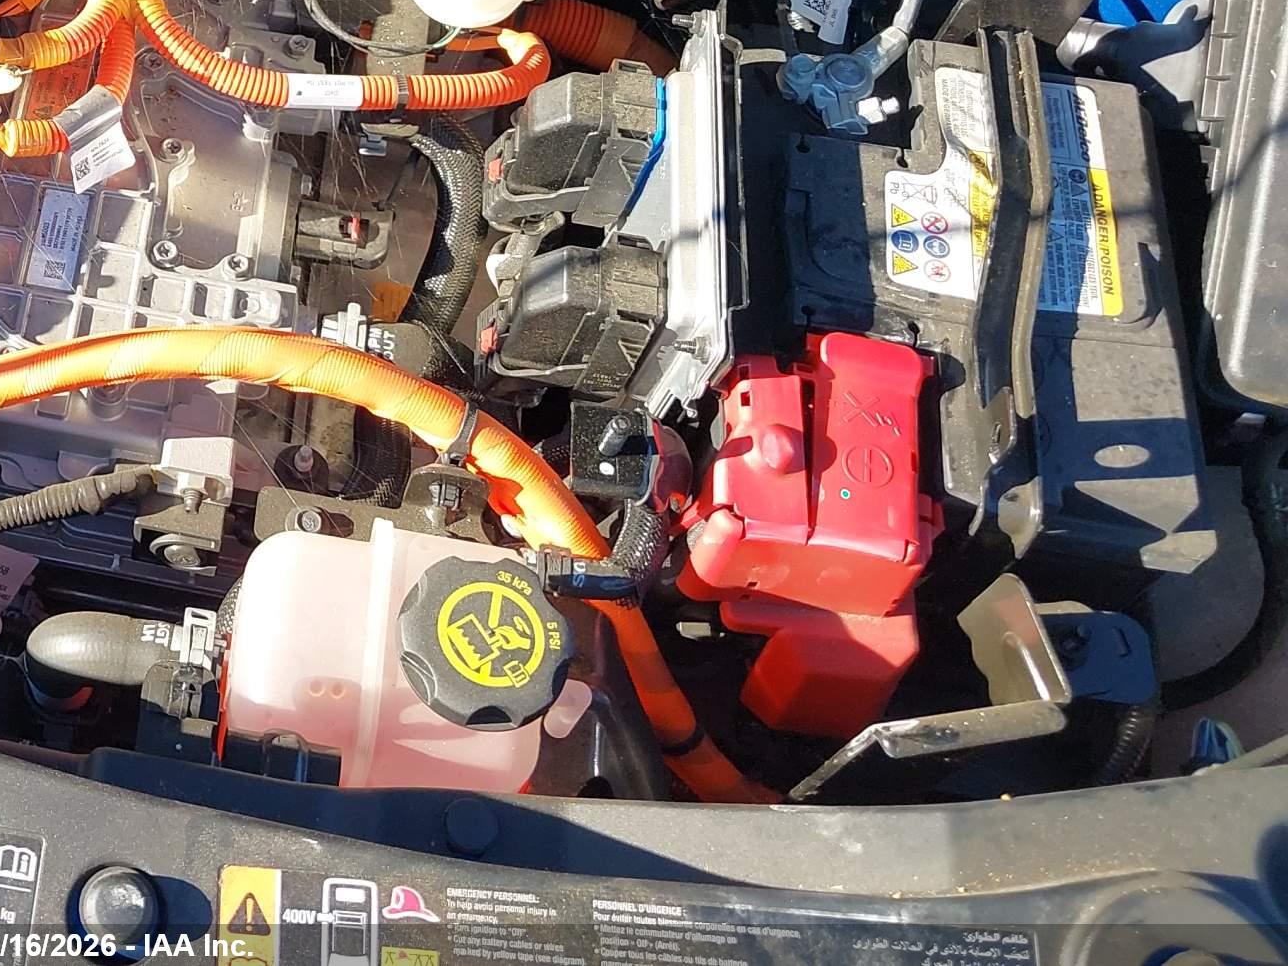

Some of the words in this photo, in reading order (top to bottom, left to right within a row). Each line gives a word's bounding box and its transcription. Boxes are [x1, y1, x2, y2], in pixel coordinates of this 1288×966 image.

[890, 182, 900, 195] Pb
[496, 570, 513, 583] 35
[511, 576, 533, 596] kPa
[546, 621, 558, 631] 5
[548, 631, 561, 651] PSI
[446, 887, 492, 899] EMERGENCY
[493, 891, 540, 904] PERSONNEL:
[0, 906, 16, 924] kg
[446, 898, 456, 908] To
[456, 899, 473, 911] help
[474, 901, 492, 912] avoid
[494, 903, 526, 915] personal
[526, 906, 548, 918] injury
[548, 907, 557, 917] in
[446, 911, 457, 920] an
[592, 899, 637, 912] PERSONNEL
[638, 903, 682, 917] D'URGENCE
[470, 924, 498, 935] ignition
[498, 927, 507, 935] to
[592, 911, 610, 922] Pour
[611, 913, 633, 923] éviter
[633, 915, 657, 925] toutes
[657, 917, 693, 928] blessures
[694, 920, 736, 933] corporelles
[735, 924, 746, 933] en
[747, 925, 761, 935] cas
[600, 923, 626, 934] Mettez
[626, 926, 634, 935] le
[634, 927, 684, 939] commutateur
[684, 930, 726, 945] d'allumage
[726, 936, 738, 945] en
[600, 936, 630, 947] position
[453, 934, 468, 943] Cut
[467, 936, 481, 946] any
[481, 937, 508, 949] battery
[508, 940, 533, 950] cables
[533, 943, 544, 951] or
[543, 943, 565, 953] wires
[453, 947, 482, 957] marked
[482, 948, 492, 960] by
[492, 950, 517, 961] yellow
[517, 951, 534, 963] tape
[535, 953, 552, 964] (see
[600, 947, 628, 959] Couper
[627, 948, 645, 959] tous
[645, 950, 657, 960] les
[657, 951, 684, 963] câbles
[683, 955, 694, 964] ou
[707, 957, 718, 966] de
